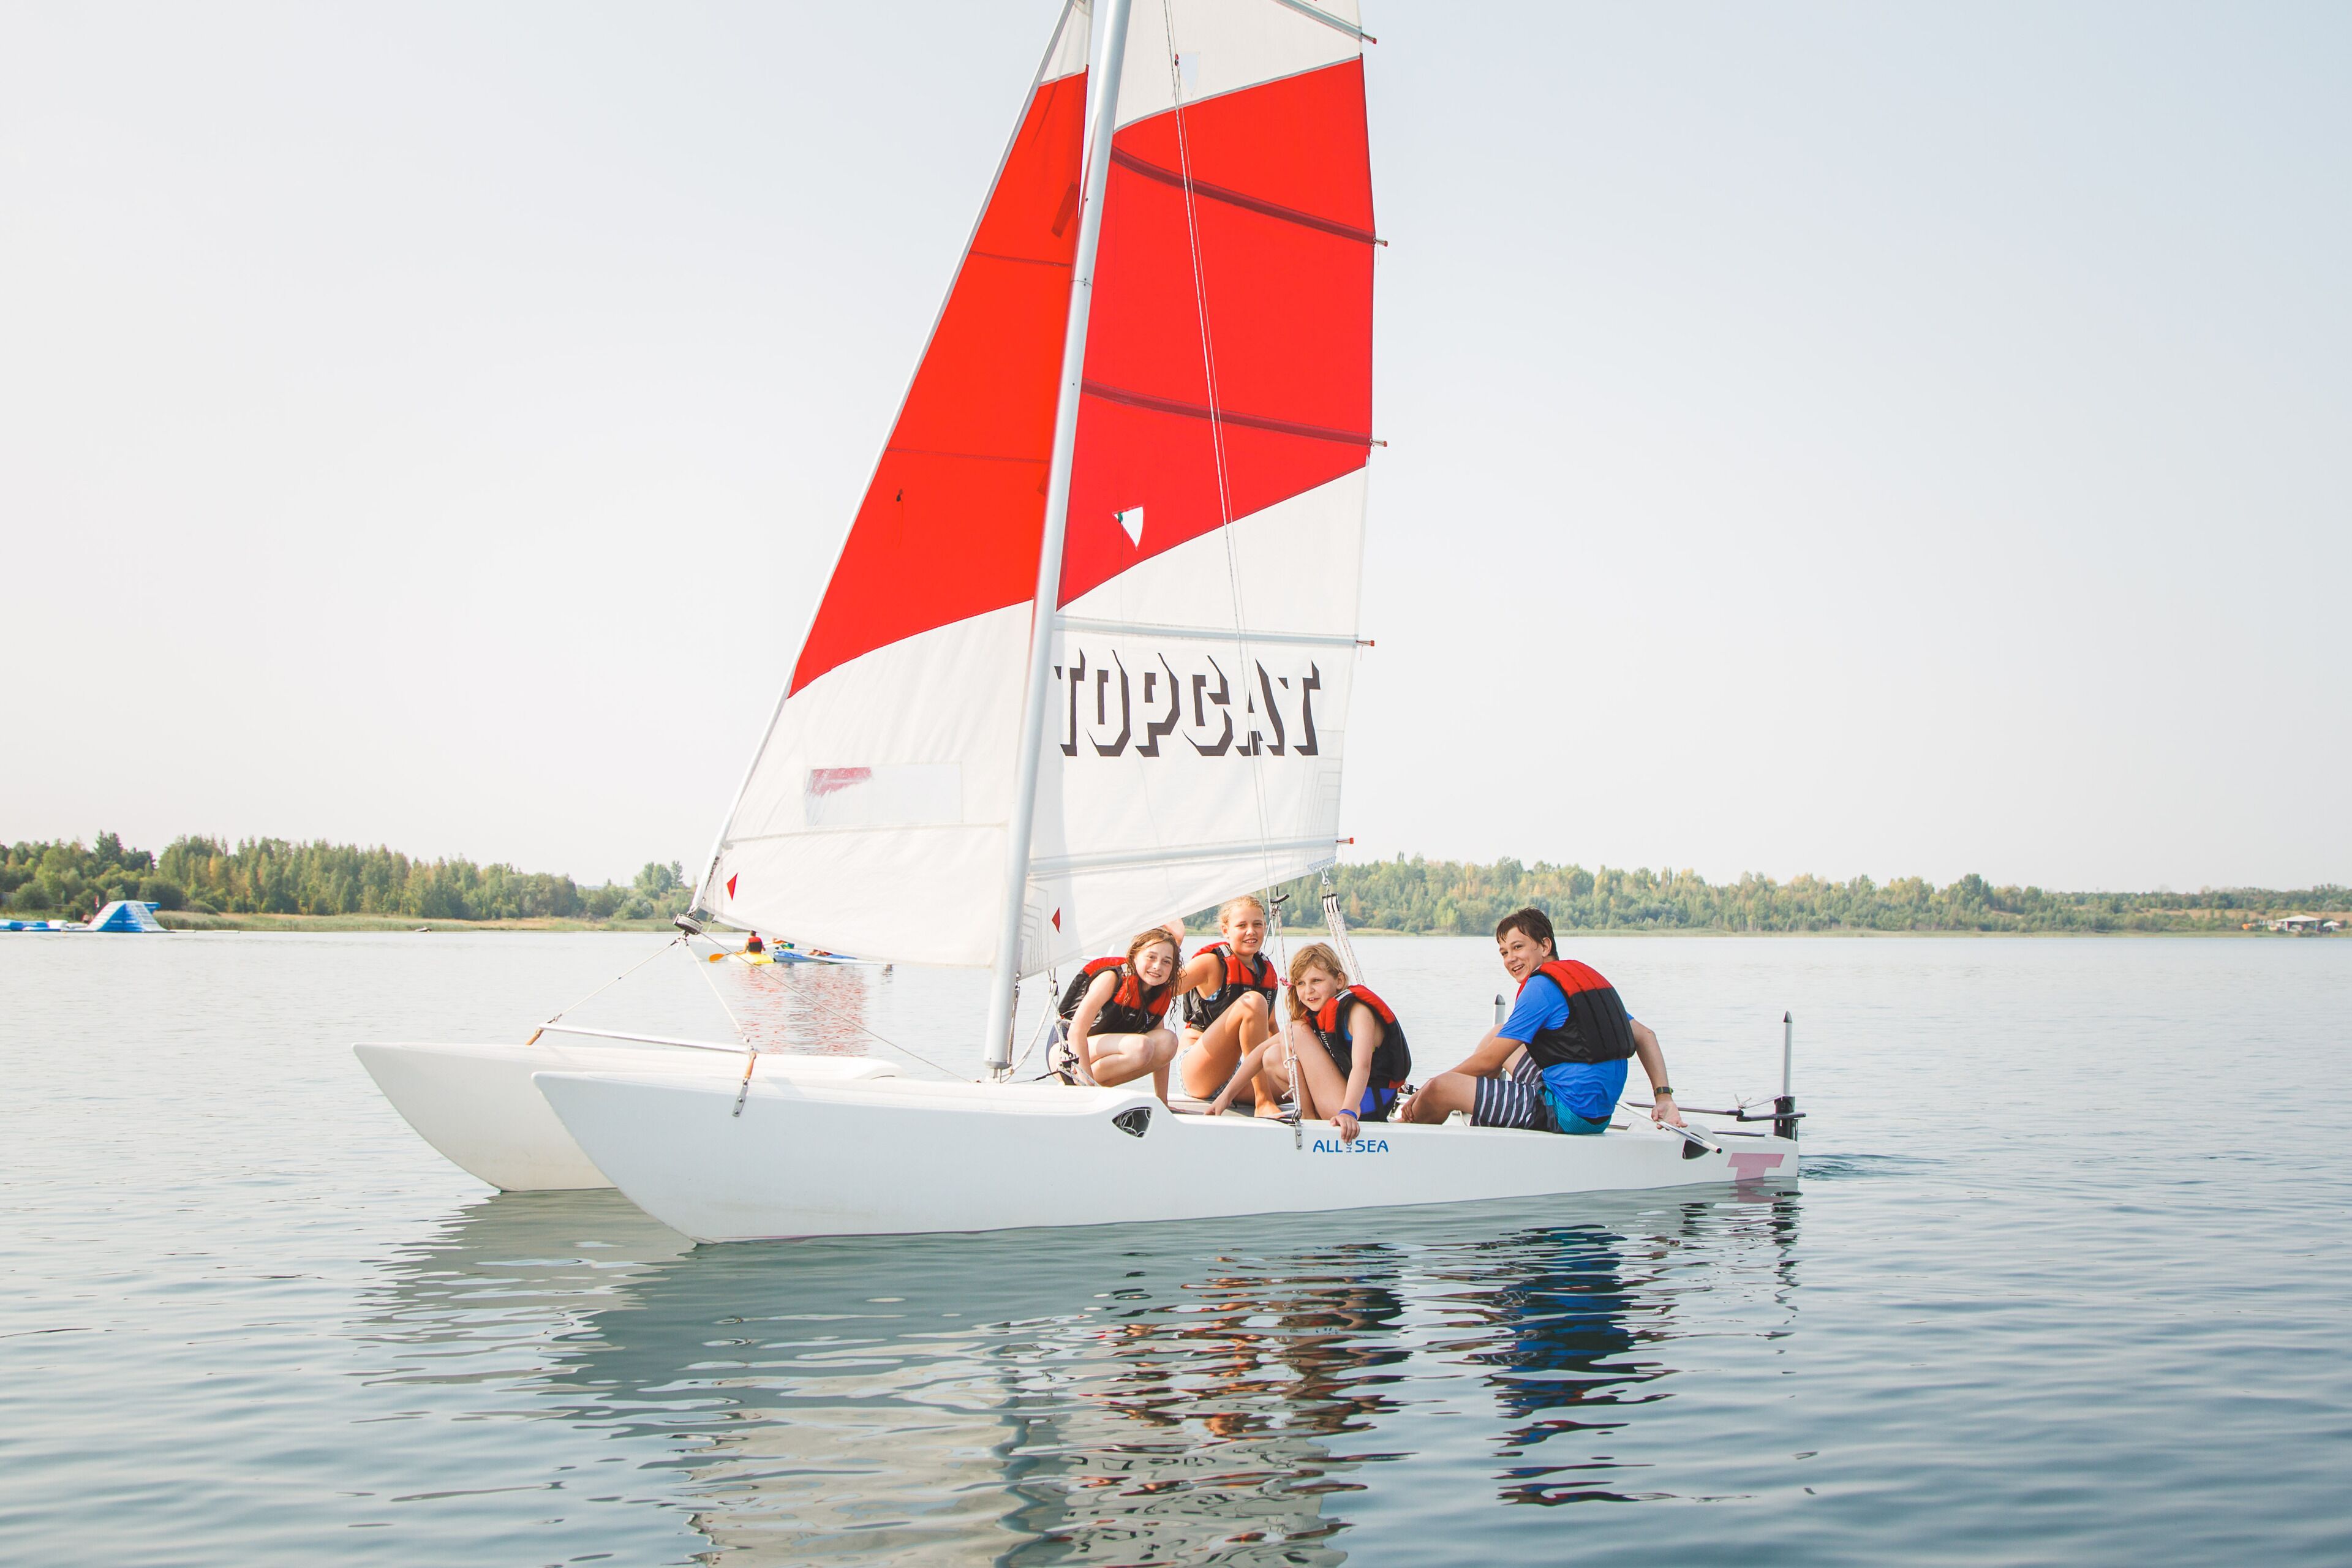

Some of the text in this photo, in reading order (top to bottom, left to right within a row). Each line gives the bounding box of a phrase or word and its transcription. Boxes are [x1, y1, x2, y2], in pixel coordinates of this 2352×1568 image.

[1053, 647, 1321, 758] TOPCAT
[1313, 1139, 1343, 1153] ALL
[1355, 1139, 1389, 1153] SEA
